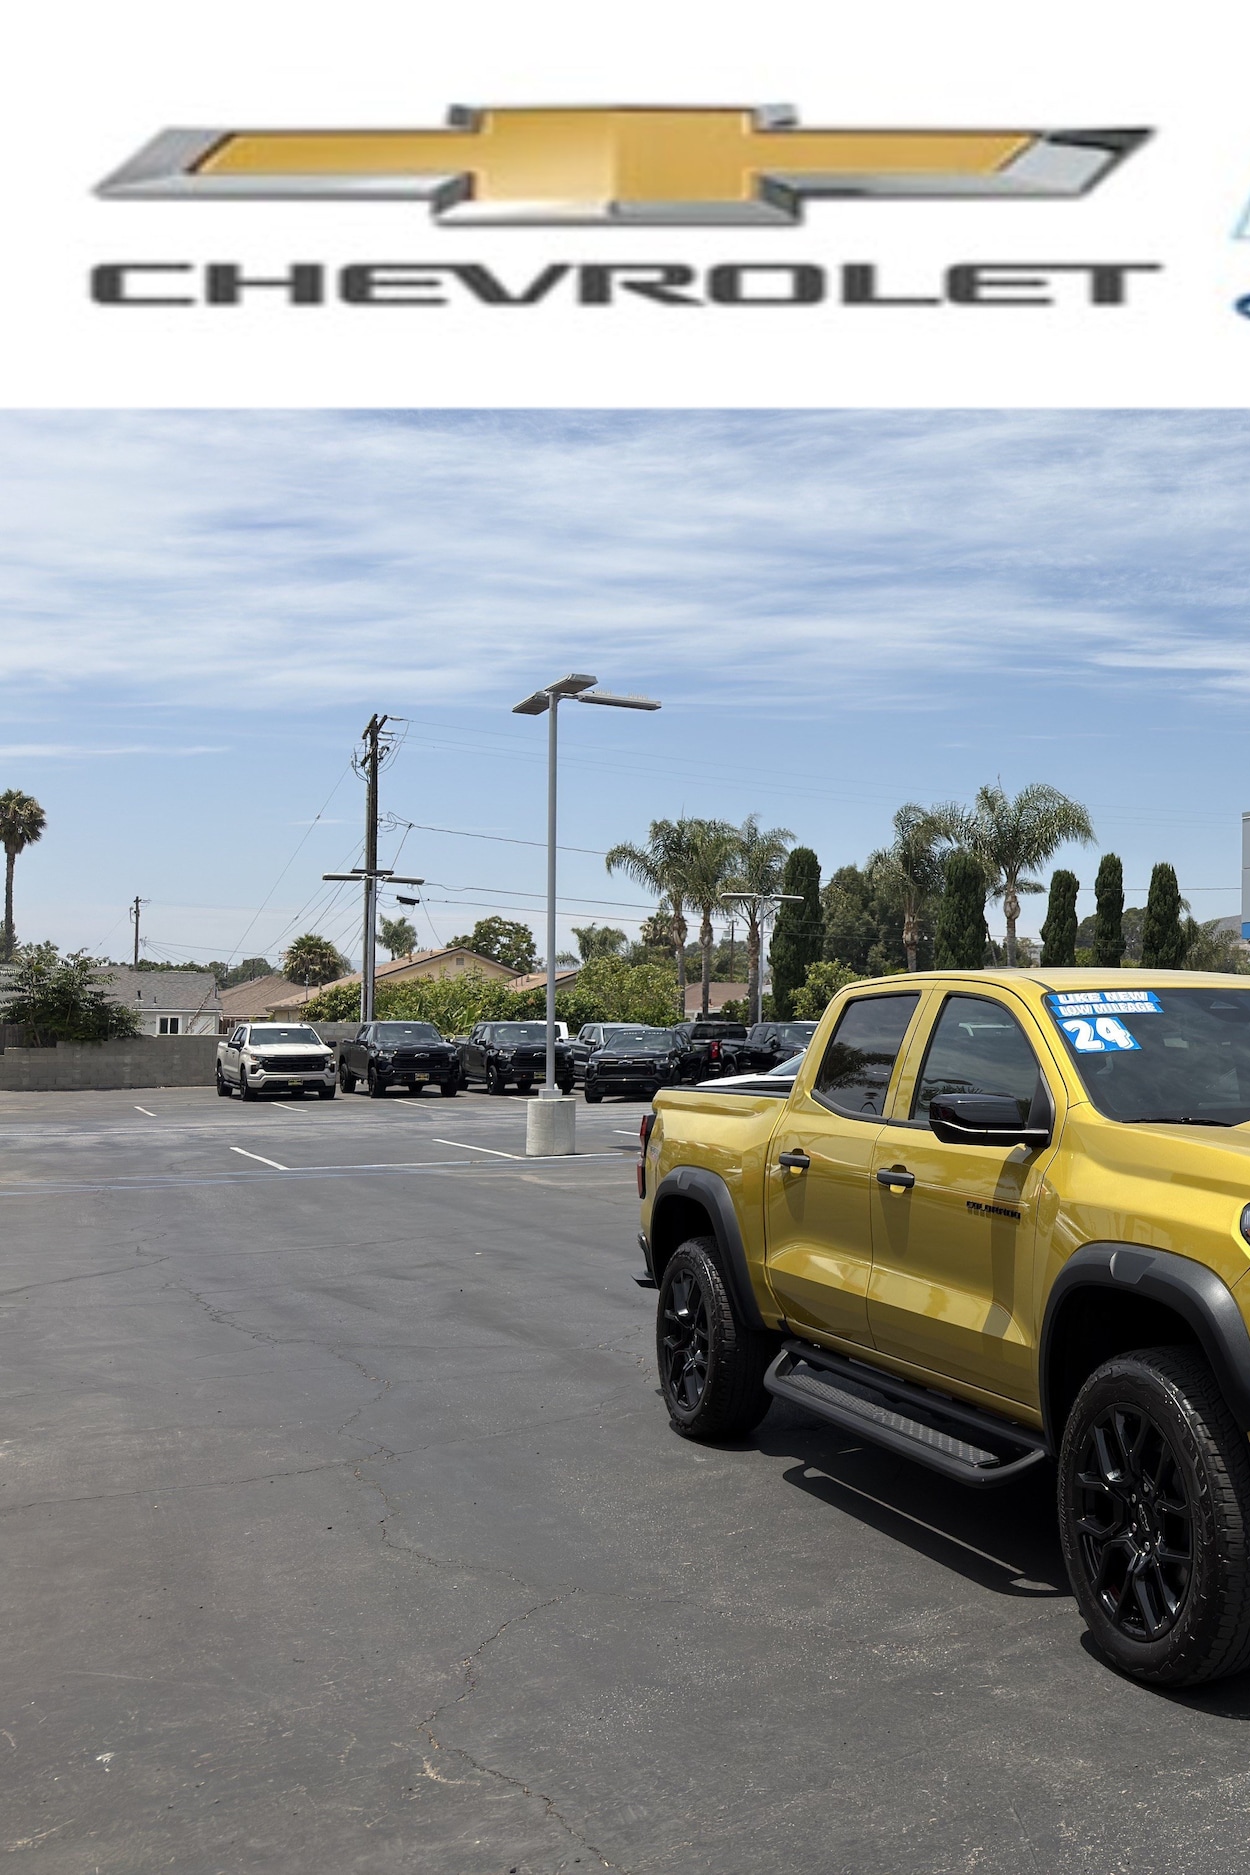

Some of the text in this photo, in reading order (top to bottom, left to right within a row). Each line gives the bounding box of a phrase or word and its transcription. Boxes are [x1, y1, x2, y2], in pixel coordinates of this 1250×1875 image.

[1103, 991, 1149, 1002] NEW
[1058, 1002, 1158, 1017] LOW MILEAGE
[1062, 1017, 1134, 1051] 24
